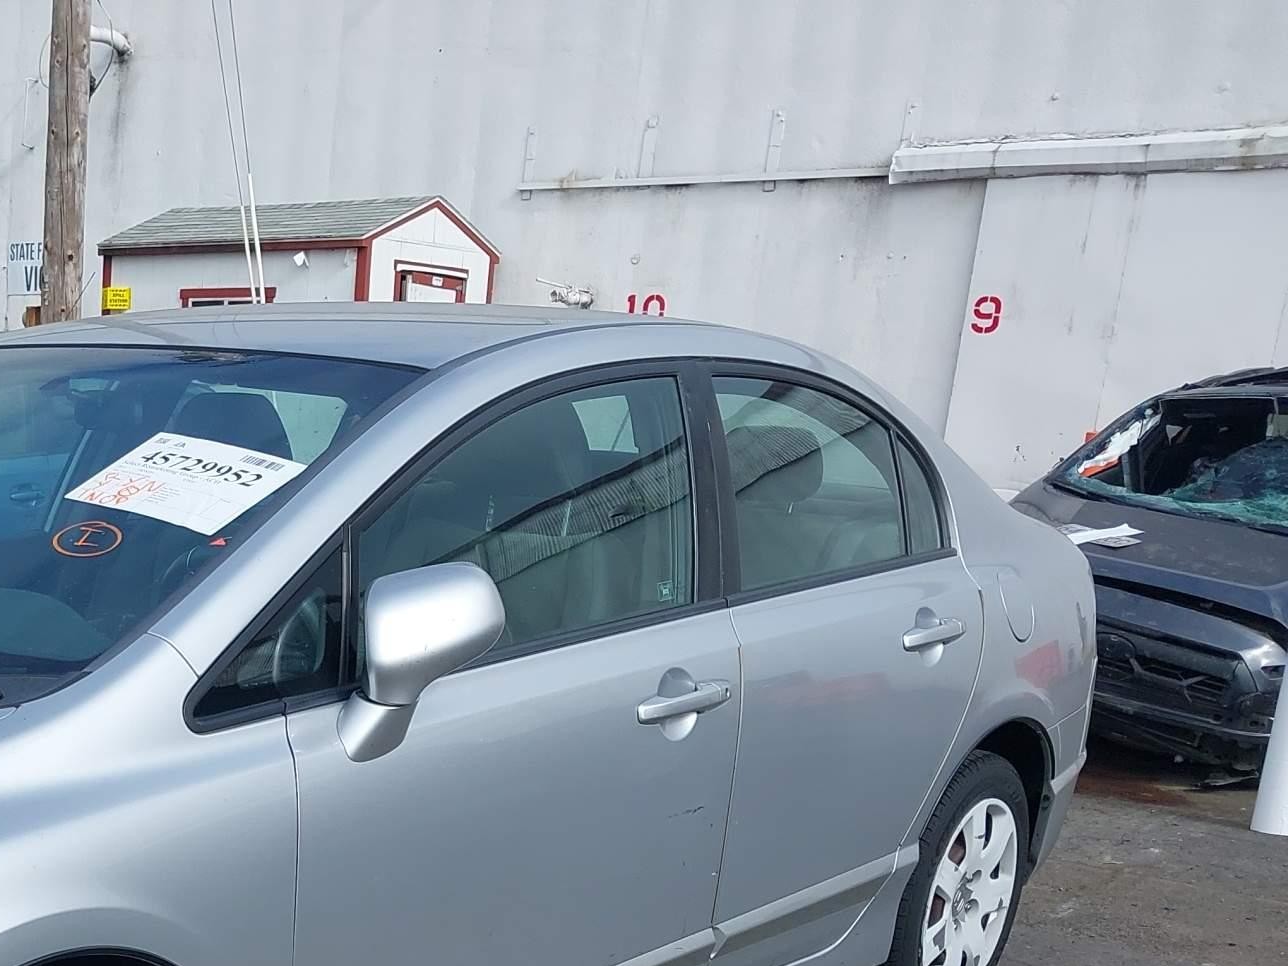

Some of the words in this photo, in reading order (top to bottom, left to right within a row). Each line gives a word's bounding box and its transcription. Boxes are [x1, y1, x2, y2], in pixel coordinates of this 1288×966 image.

[9, 242, 35, 262] STATE
[970, 295, 1002, 334] 9
[141, 450, 263, 487] 45729952
